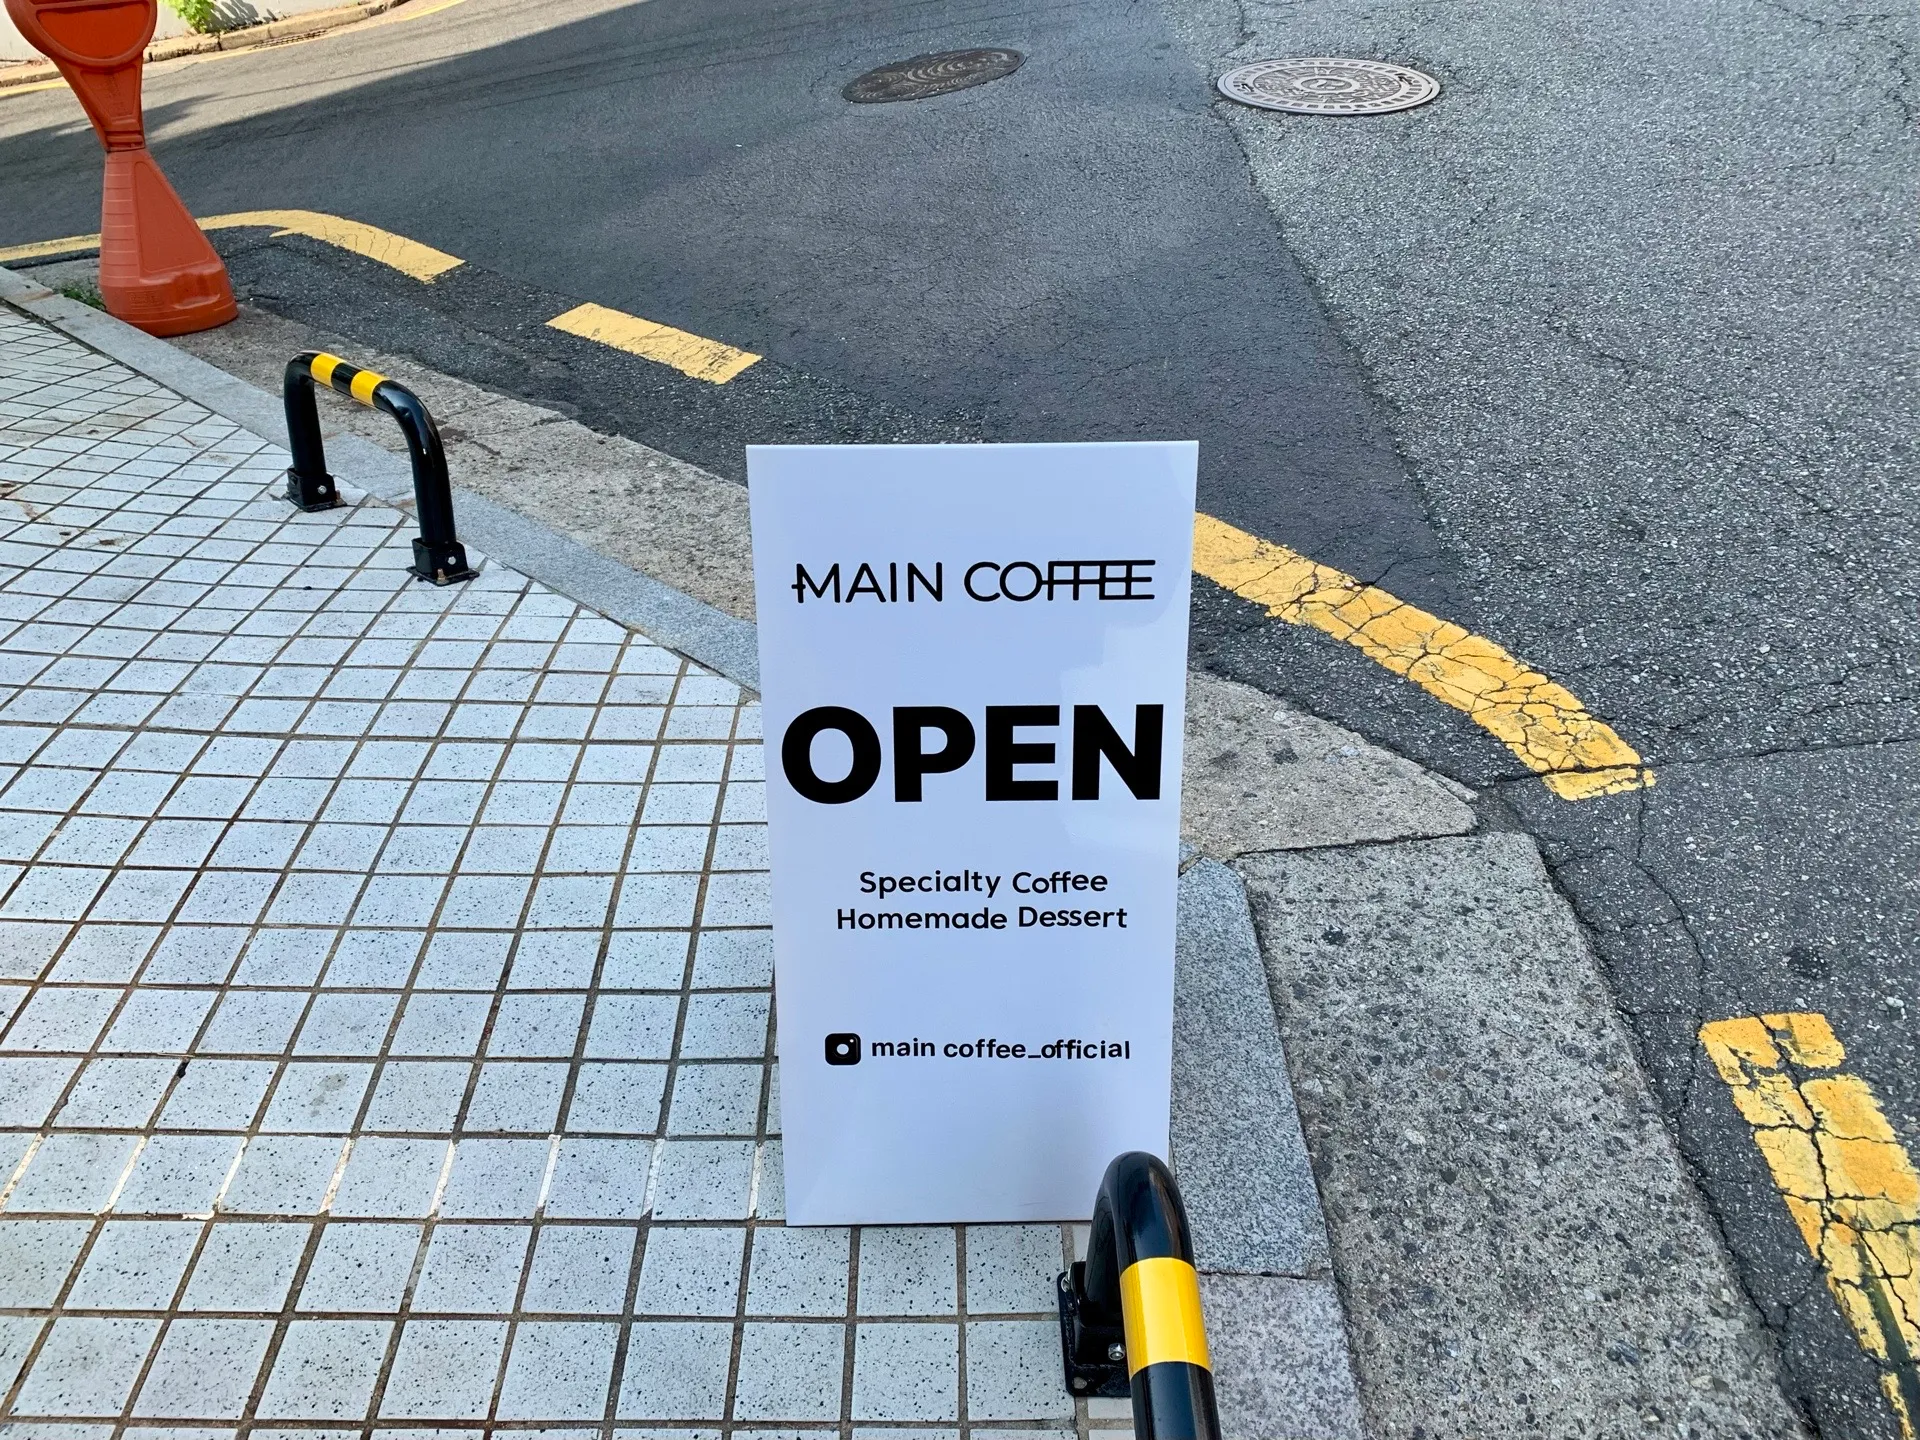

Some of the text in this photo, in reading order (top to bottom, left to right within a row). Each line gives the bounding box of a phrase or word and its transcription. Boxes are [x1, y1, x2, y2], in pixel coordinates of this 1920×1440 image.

[791, 560, 1156, 603] MAIN COFFEE
[781, 704, 1164, 805] OPEN
[859, 870, 1108, 899] Specialty Coffee
[837, 906, 1128, 930] Homemade Dessert
[871, 1038, 1130, 1059] main coffee_official
